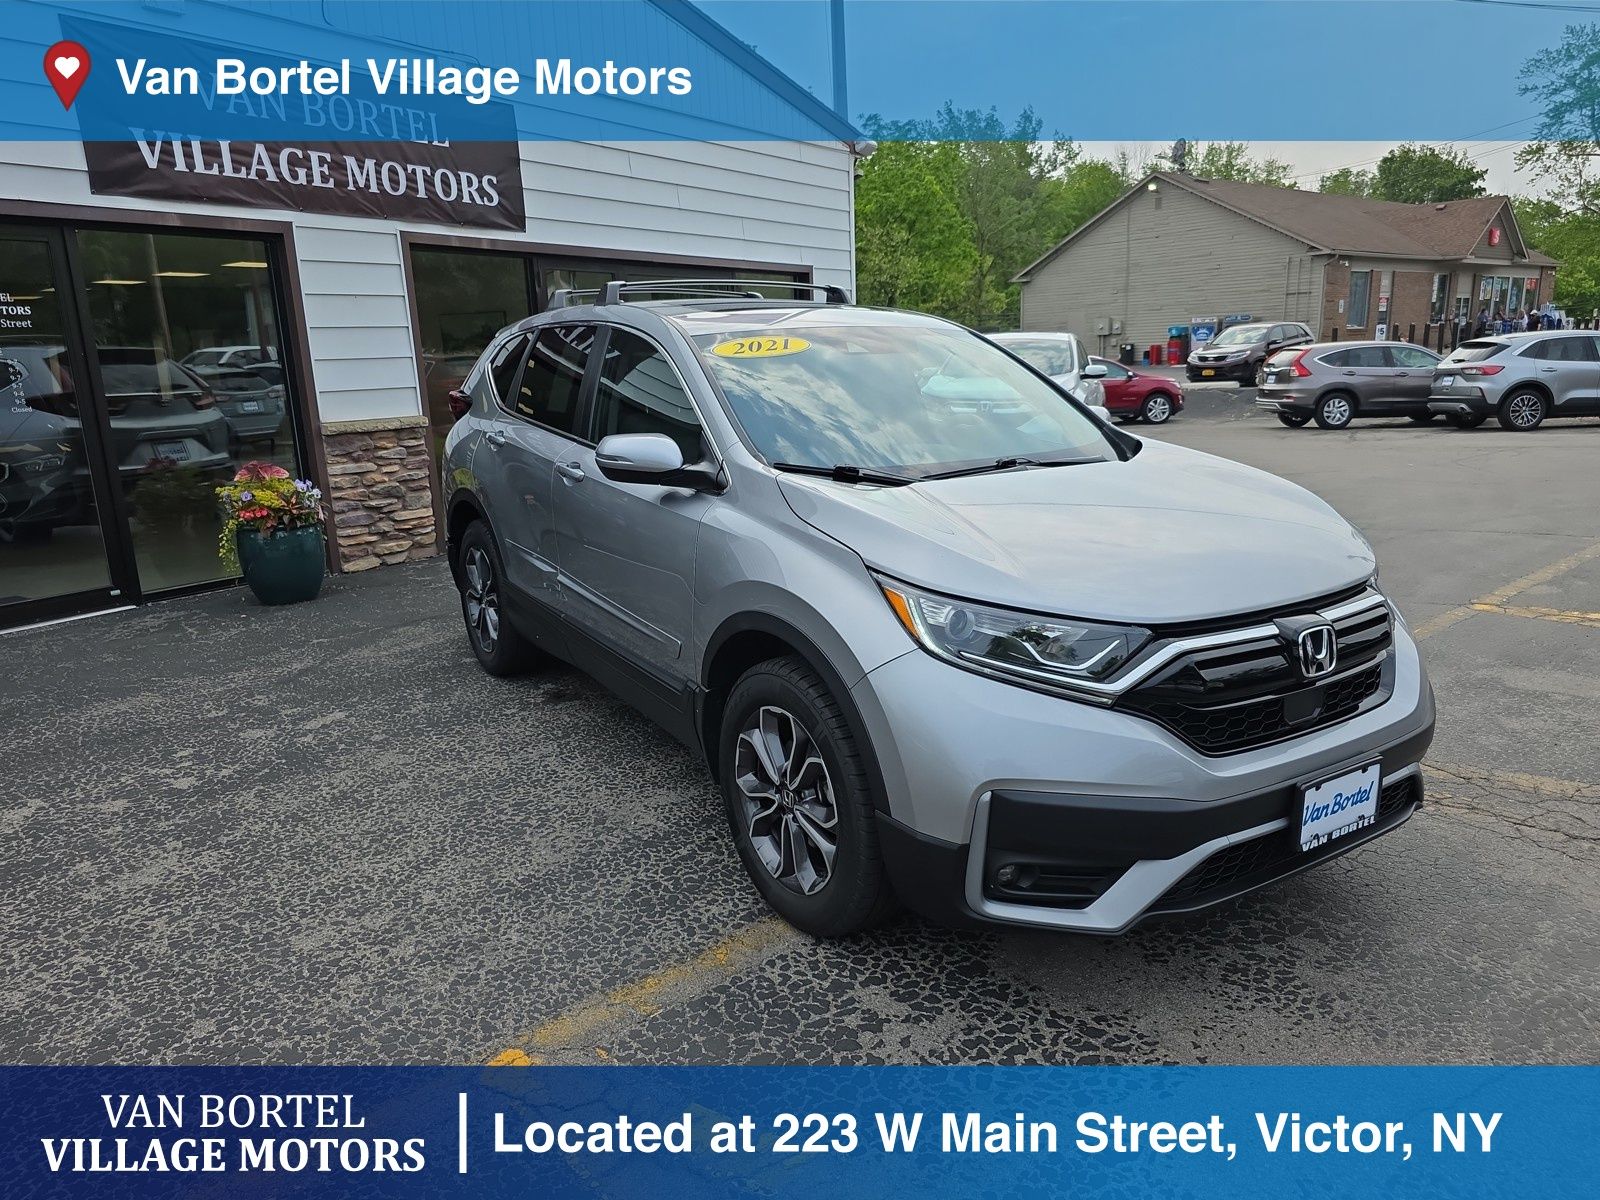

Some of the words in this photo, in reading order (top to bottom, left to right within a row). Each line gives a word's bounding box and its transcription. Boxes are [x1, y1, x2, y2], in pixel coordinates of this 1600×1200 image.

[299, 91, 450, 147] BORTEL
[128, 126, 335, 188] VILLAGE
[343, 155, 499, 207] MOTORS
[0, 319, 32, 328] Street
[733, 339, 789, 354] 2021
[1303, 802, 1330, 826] Van
[1330, 781, 1374, 815] Bortel
[1331, 816, 1375, 840] BORTEL
